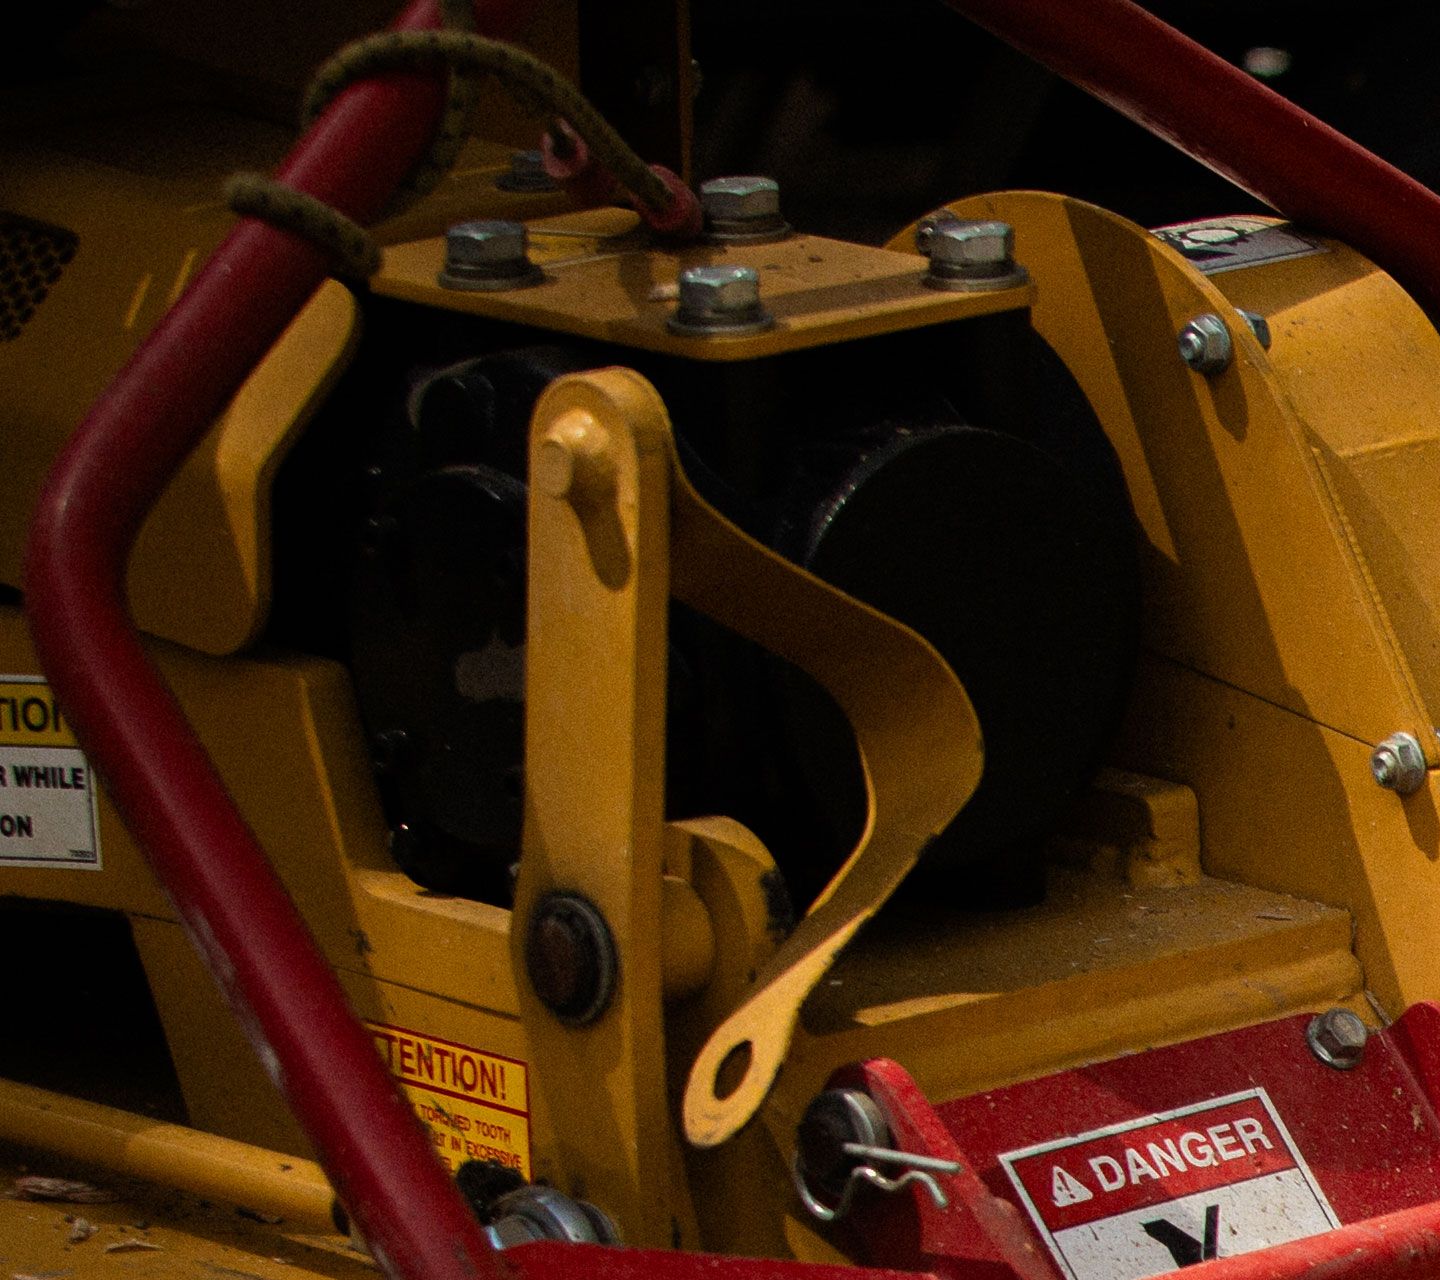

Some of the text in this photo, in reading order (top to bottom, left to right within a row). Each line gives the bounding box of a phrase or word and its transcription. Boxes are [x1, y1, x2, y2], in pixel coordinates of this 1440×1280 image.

[12, 766, 85, 790] WHILE
[475, 1120, 512, 1144] TOOTH
[451, 1136, 462, 1151] IN
[465, 1140, 522, 1171] EXCESSIVE
[1088, 1117, 1274, 1193] DANGER
